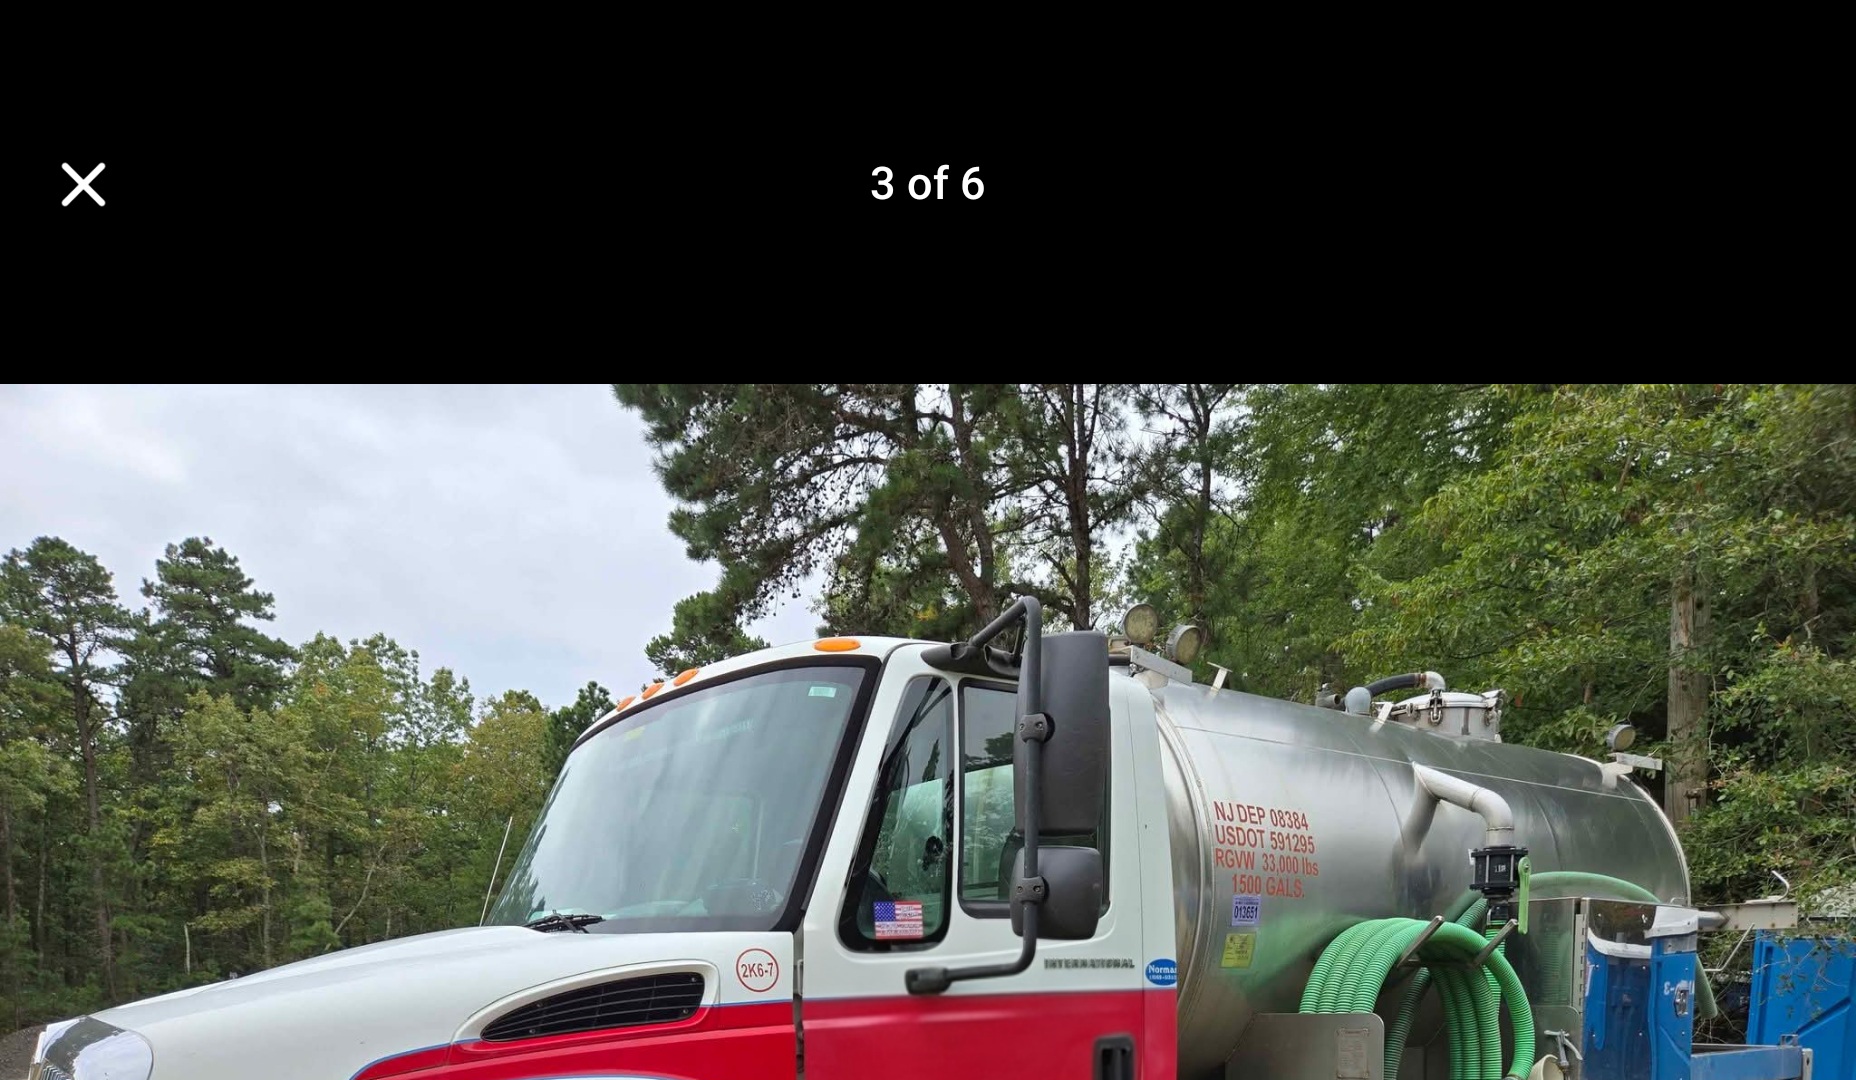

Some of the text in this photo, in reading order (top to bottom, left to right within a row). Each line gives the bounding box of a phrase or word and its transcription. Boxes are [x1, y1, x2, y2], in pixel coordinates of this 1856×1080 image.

[1213, 801, 1309, 831] NJ DEP 08384
[1214, 824, 1315, 854] USDOT 591295
[1215, 848, 1319, 876] RGVW 33,000 lbs
[1232, 874, 1305, 898] 1500 GALS.
[741, 962, 774, 978] 2K6-7
[1044, 958, 1135, 969] INTERNATIONAL
